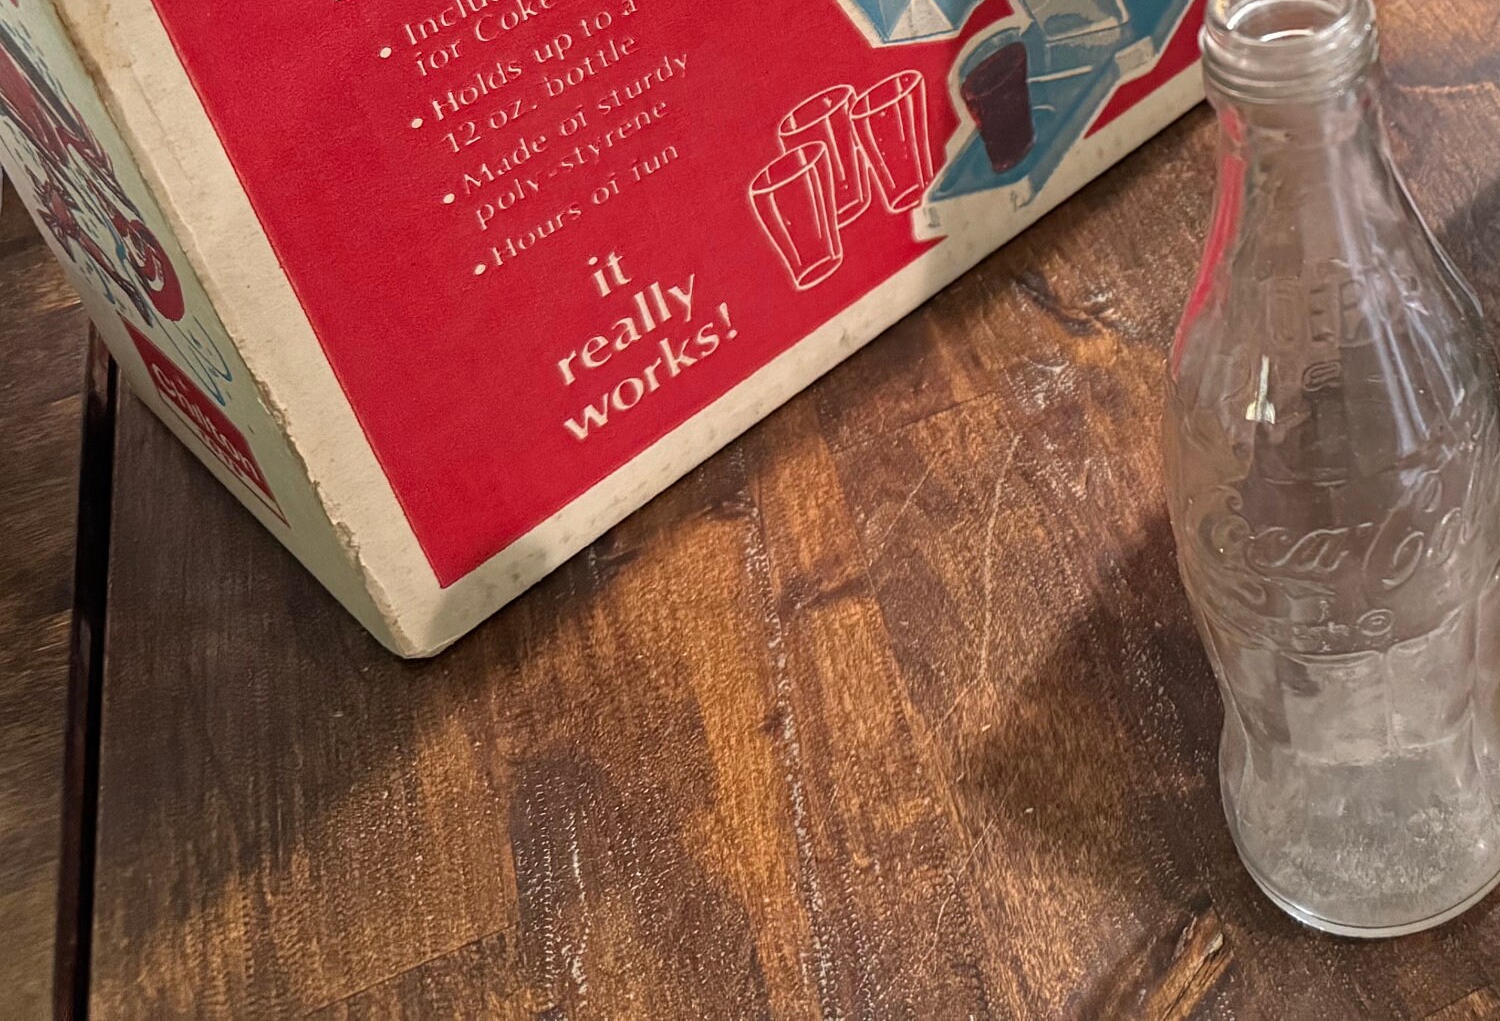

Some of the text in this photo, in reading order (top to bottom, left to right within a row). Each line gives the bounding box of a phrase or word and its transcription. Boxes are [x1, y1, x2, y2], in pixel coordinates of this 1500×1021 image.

[415, 39, 462, 76] for
[432, 60, 522, 121] Holds
[534, 33, 573, 60] up
[580, 10, 612, 37] to
[441, 37, 638, 153] 12 oz. bottle
[463, 54, 687, 194] Made of sturdy
[492, 145, 678, 266] Hours of fun
[558, 273, 695, 385] really
[588, 251, 632, 298] it
[564, 302, 738, 440] works!
